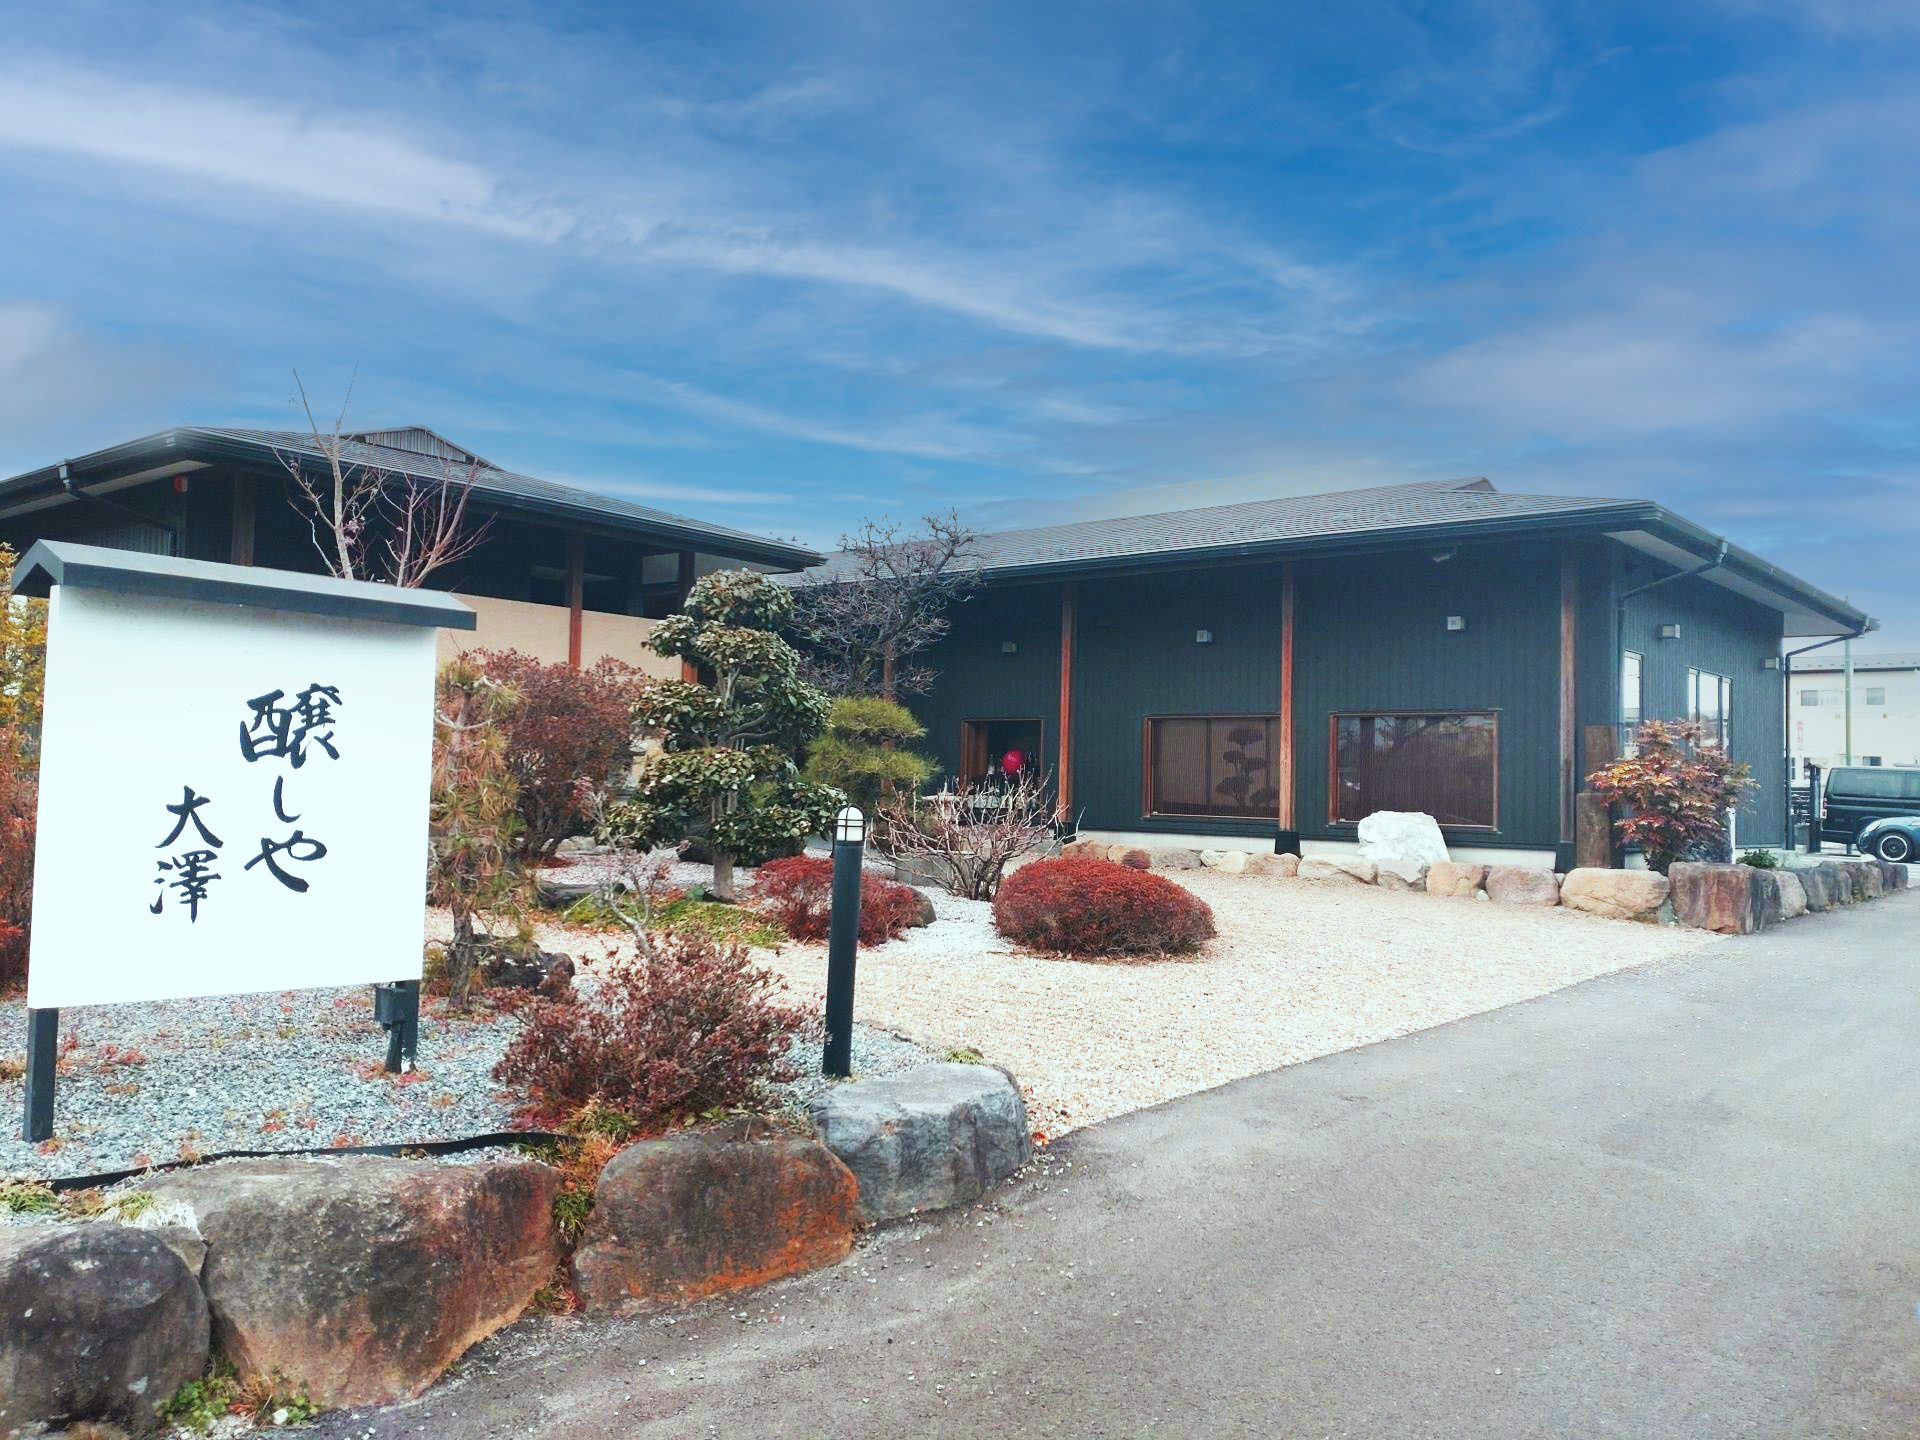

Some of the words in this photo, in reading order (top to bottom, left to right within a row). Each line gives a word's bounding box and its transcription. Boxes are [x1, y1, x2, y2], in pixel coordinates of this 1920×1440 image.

[149, 785, 224, 924] 大澤
[239, 683, 343, 893] 醸しや
